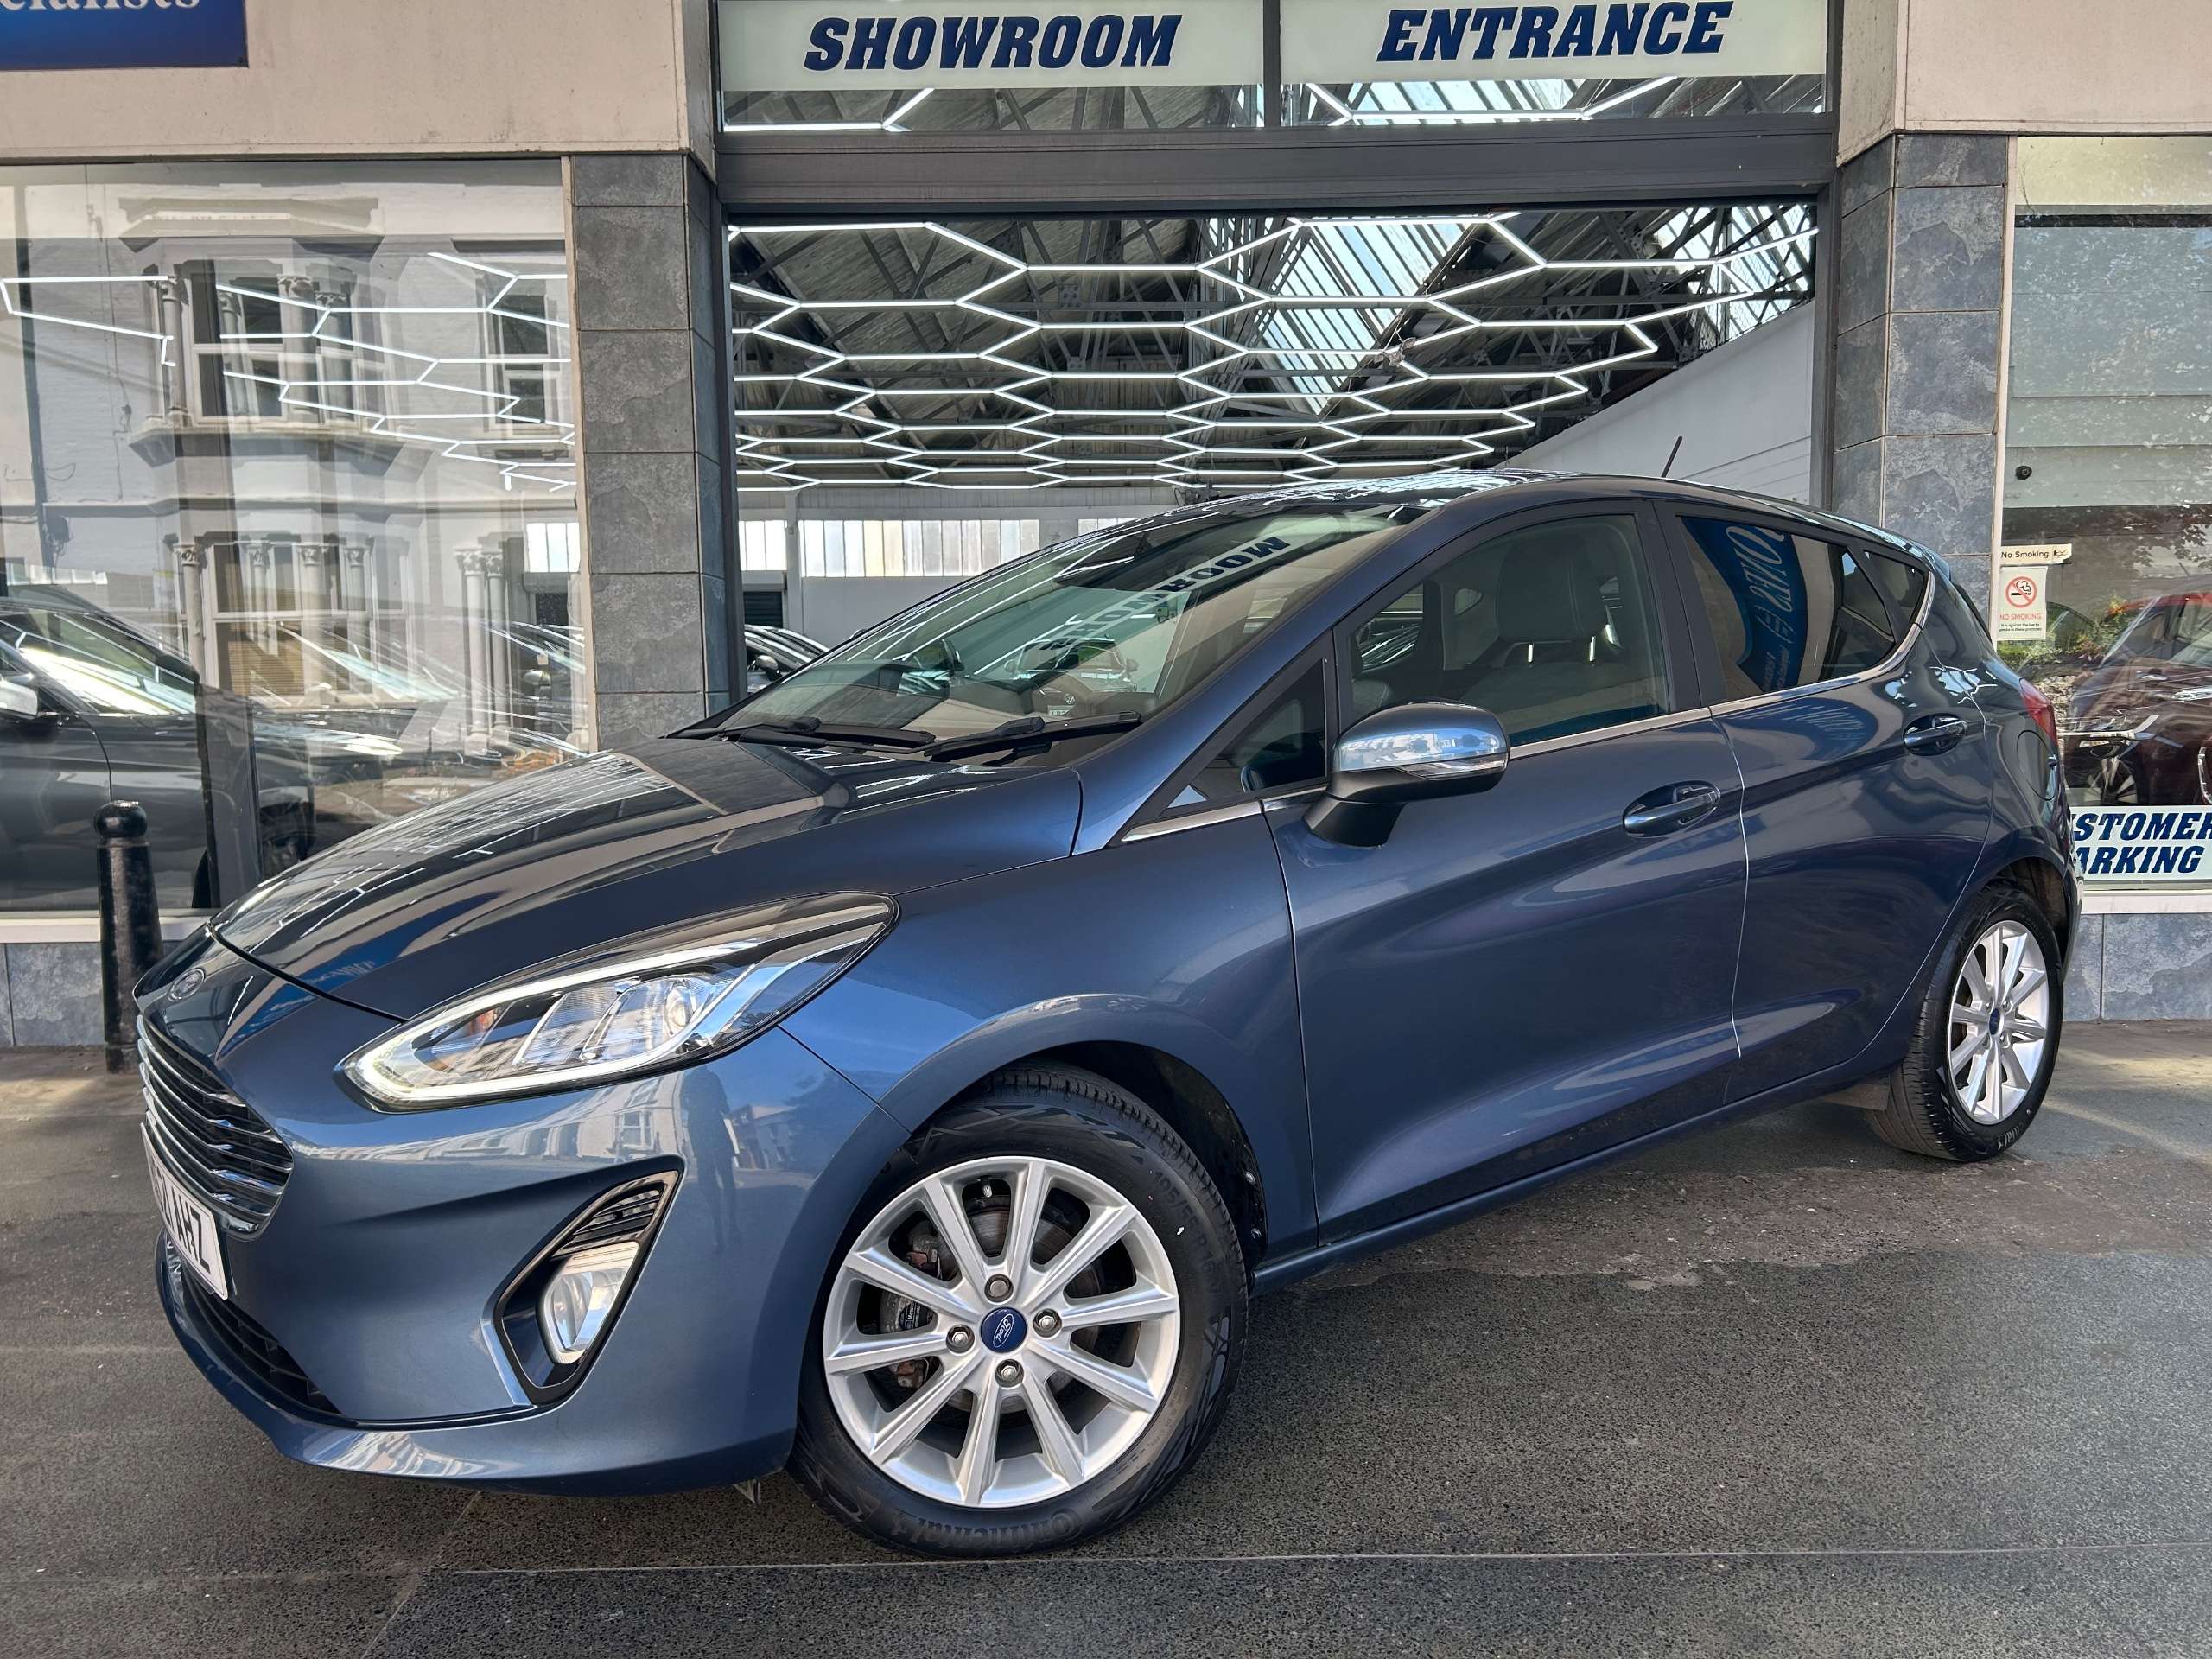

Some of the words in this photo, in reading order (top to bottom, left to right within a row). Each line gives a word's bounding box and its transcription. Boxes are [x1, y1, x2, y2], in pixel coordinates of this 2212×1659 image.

[804, 14, 1183, 72] SHOWROOM
[1376, 1, 1732, 62] ENTRANCE
[2015, 550, 2050, 559] Smoking
[2071, 812, 2212, 842] STOMER
